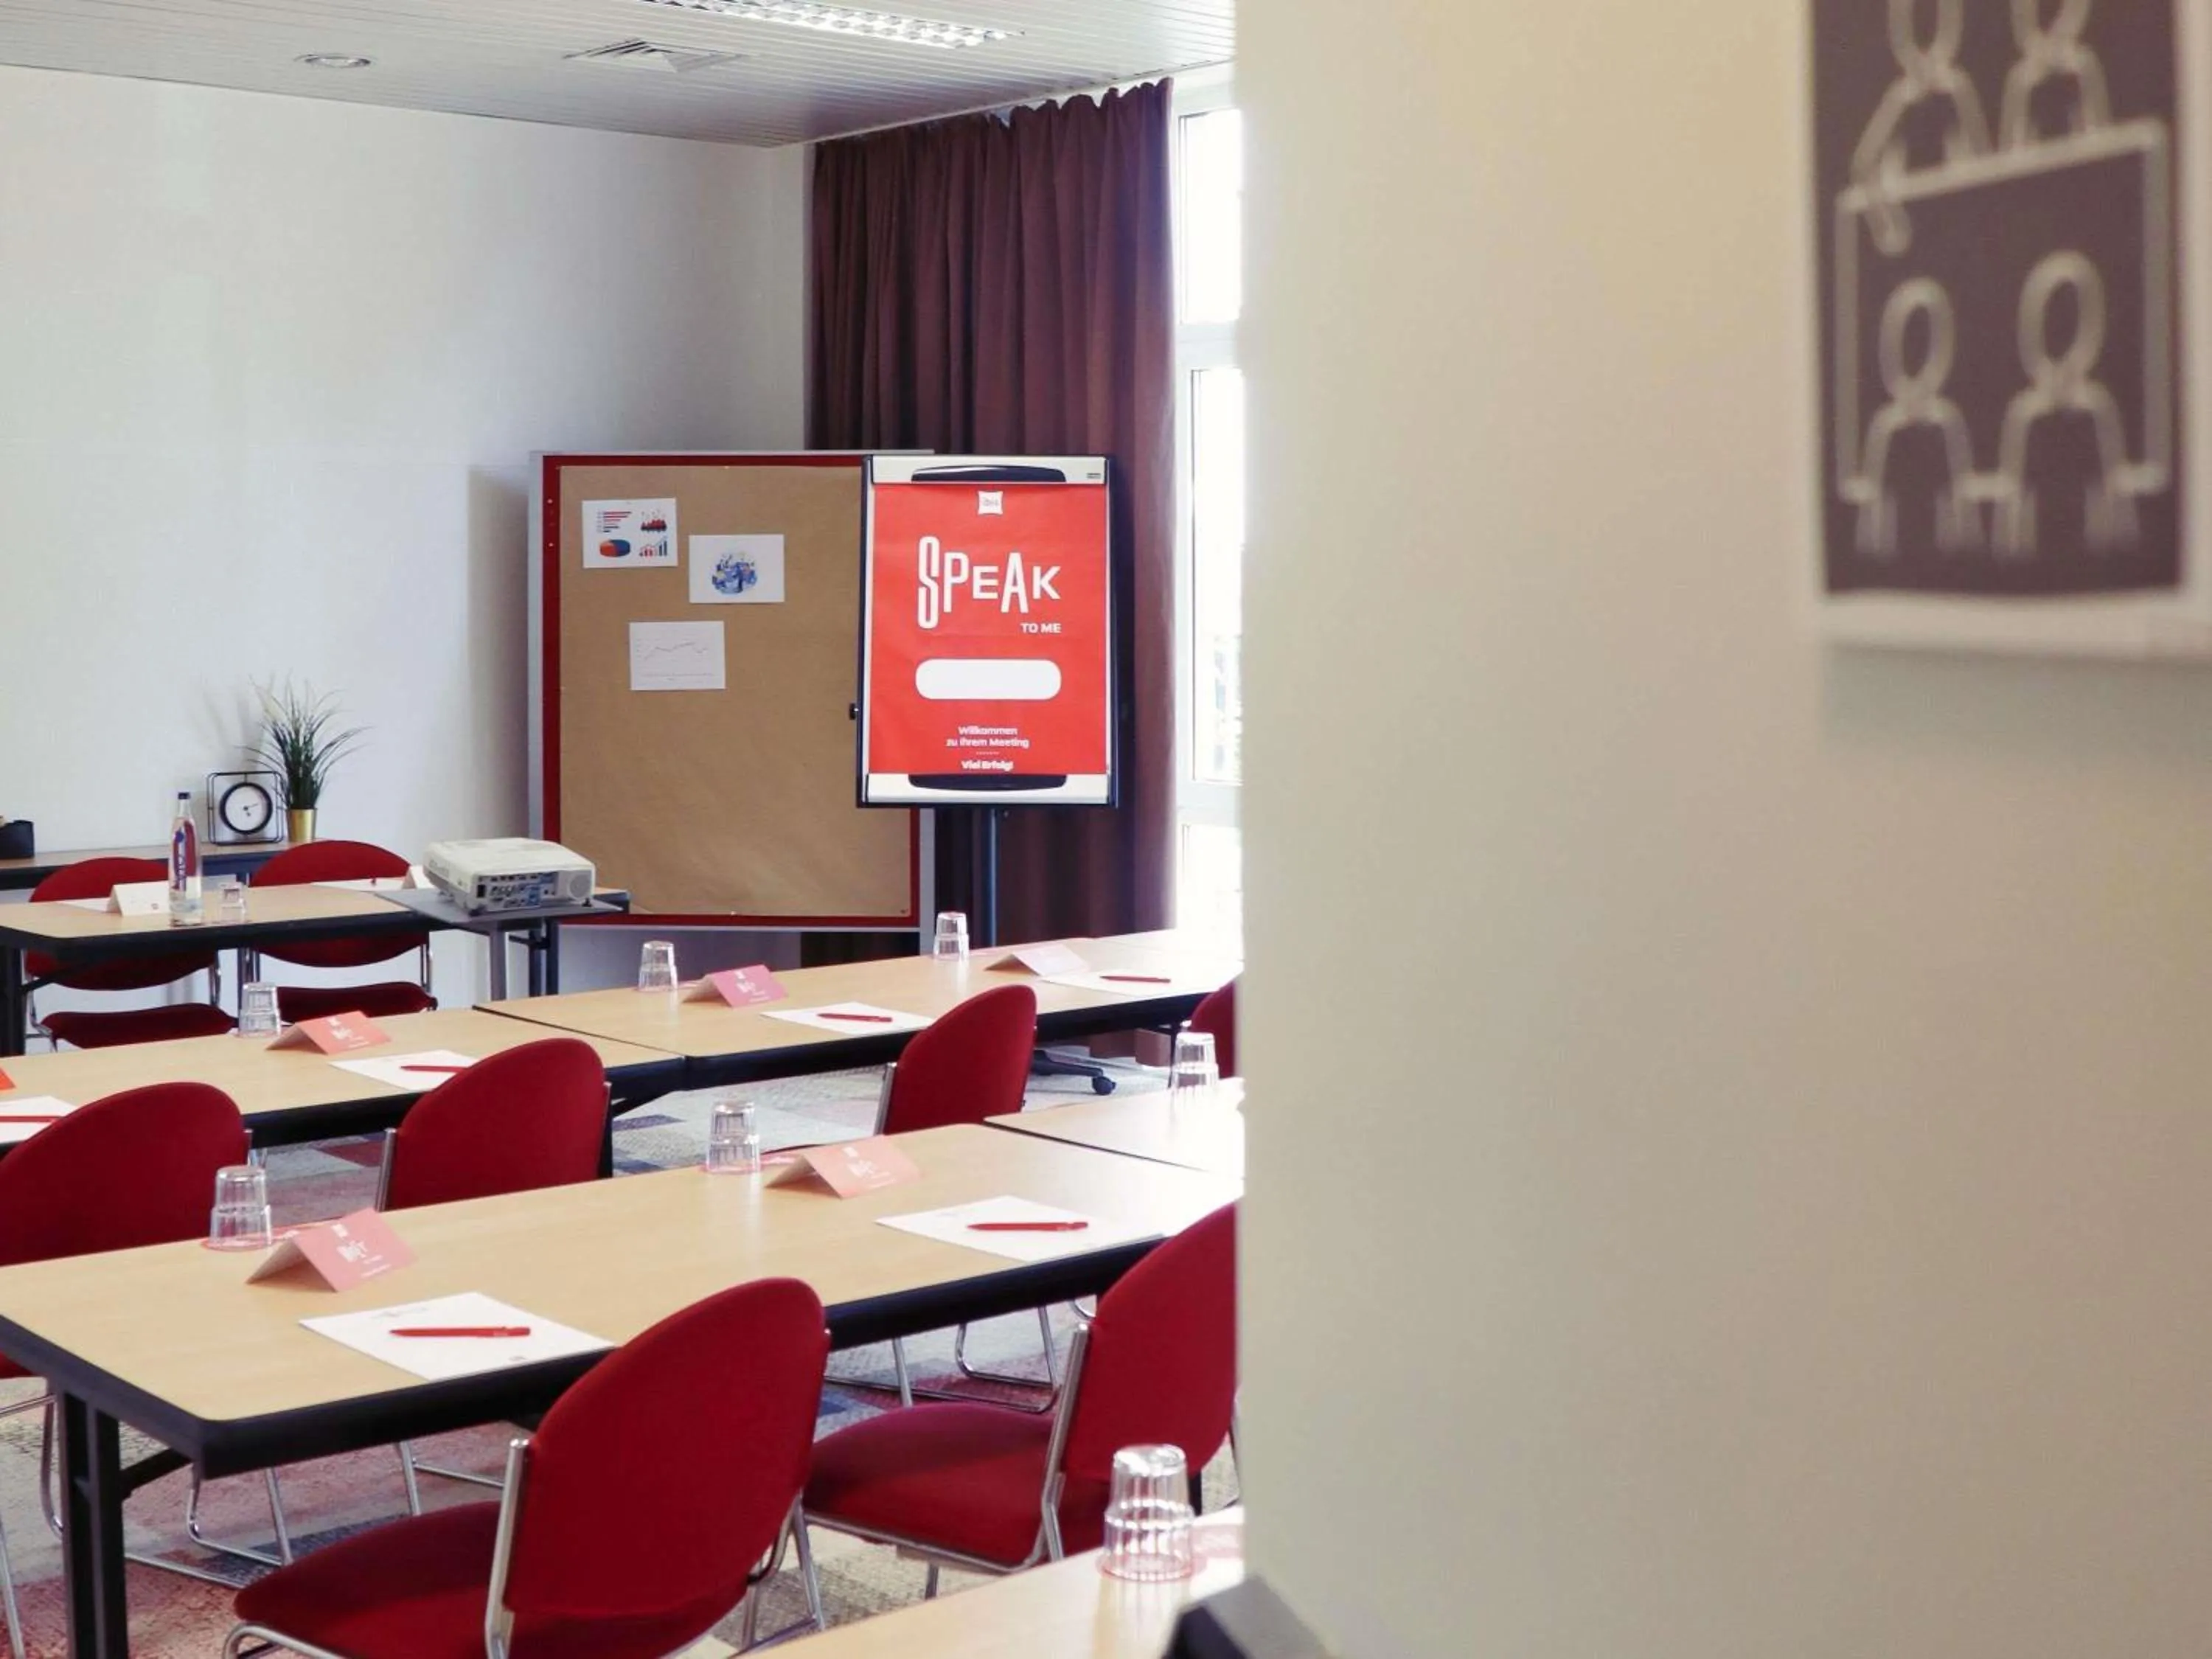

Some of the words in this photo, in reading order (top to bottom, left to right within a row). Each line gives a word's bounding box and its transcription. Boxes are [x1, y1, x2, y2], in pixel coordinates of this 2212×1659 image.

[917, 535, 1061, 629] SPEAK
[1020, 622, 1038, 633] TO
[1040, 622, 1062, 633] ME
[958, 725, 1018, 735] Willkommen
[989, 737, 1030, 749] Meeting
[961, 759, 981, 769] Viel
